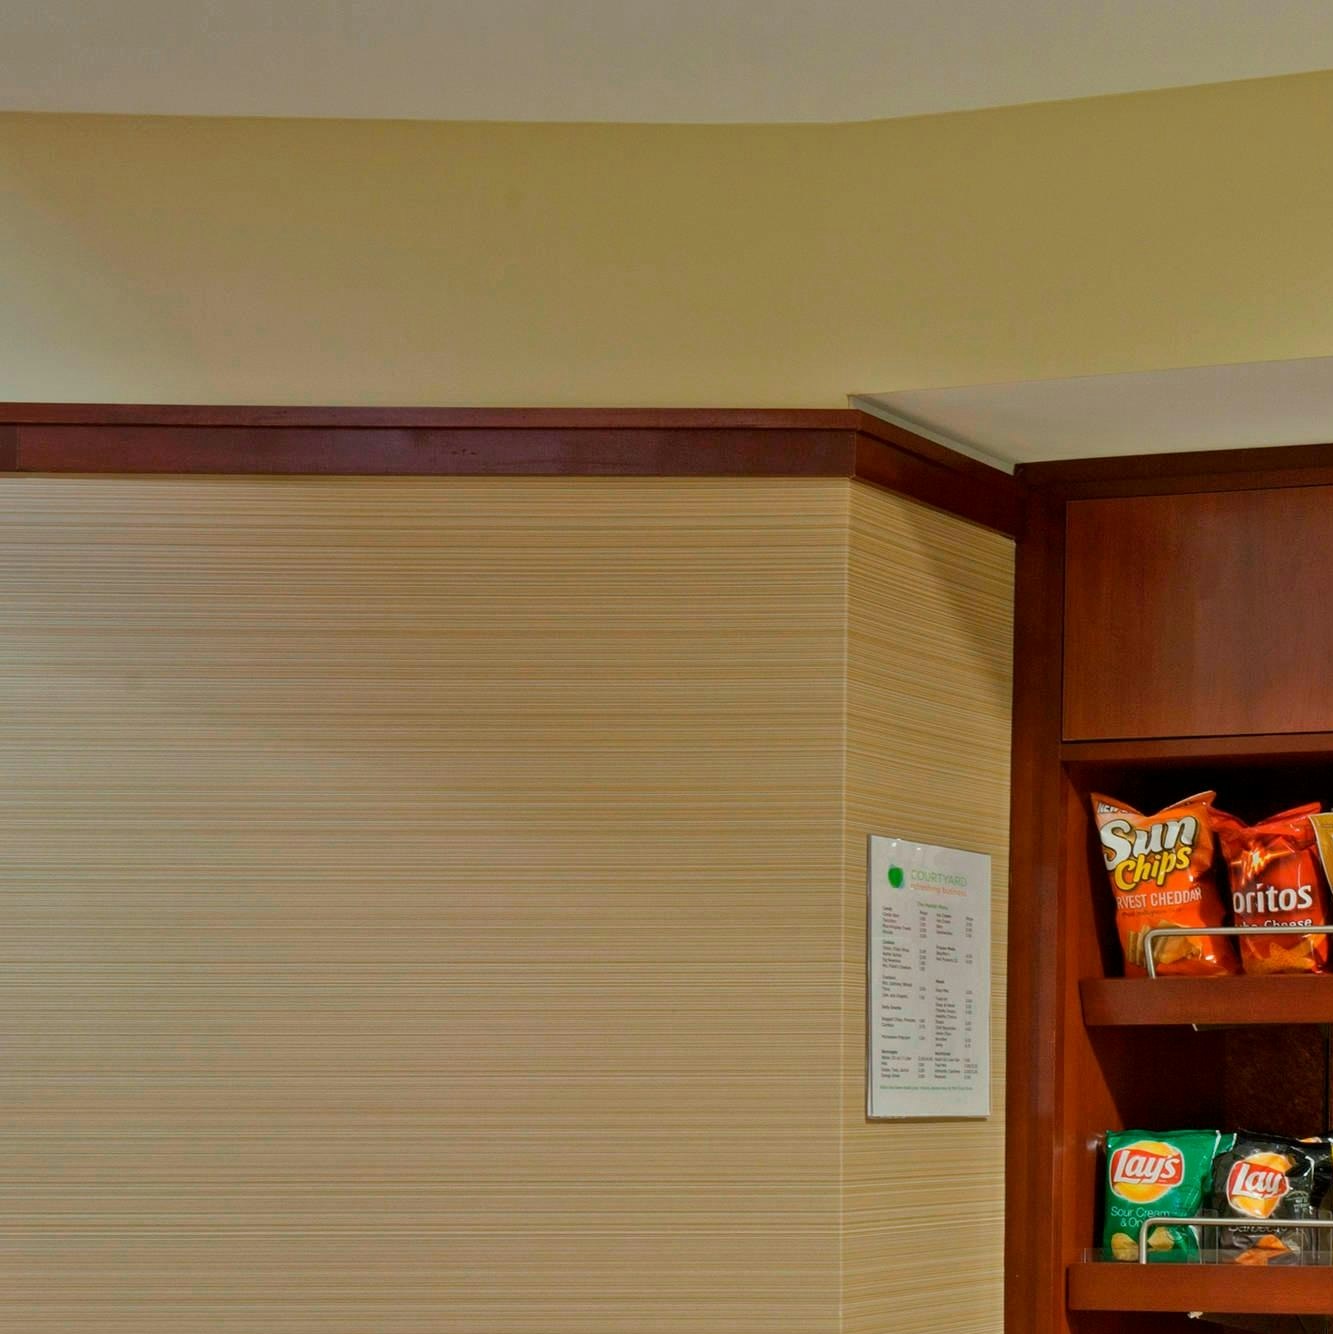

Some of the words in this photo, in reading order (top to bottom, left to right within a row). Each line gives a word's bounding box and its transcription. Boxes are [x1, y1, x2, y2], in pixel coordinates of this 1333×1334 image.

[1100, 816, 1197, 870] Sun
[1114, 847, 1192, 890] Chips
[1117, 894, 1147, 909] RVEST
[1150, 887, 1202, 907] CHEDDAR
[1233, 883, 1313, 913] oritos
[1113, 1150, 1181, 1185] Lay's
[1111, 1207, 1132, 1217] Sour
[1136, 1207, 1170, 1217] Cream
